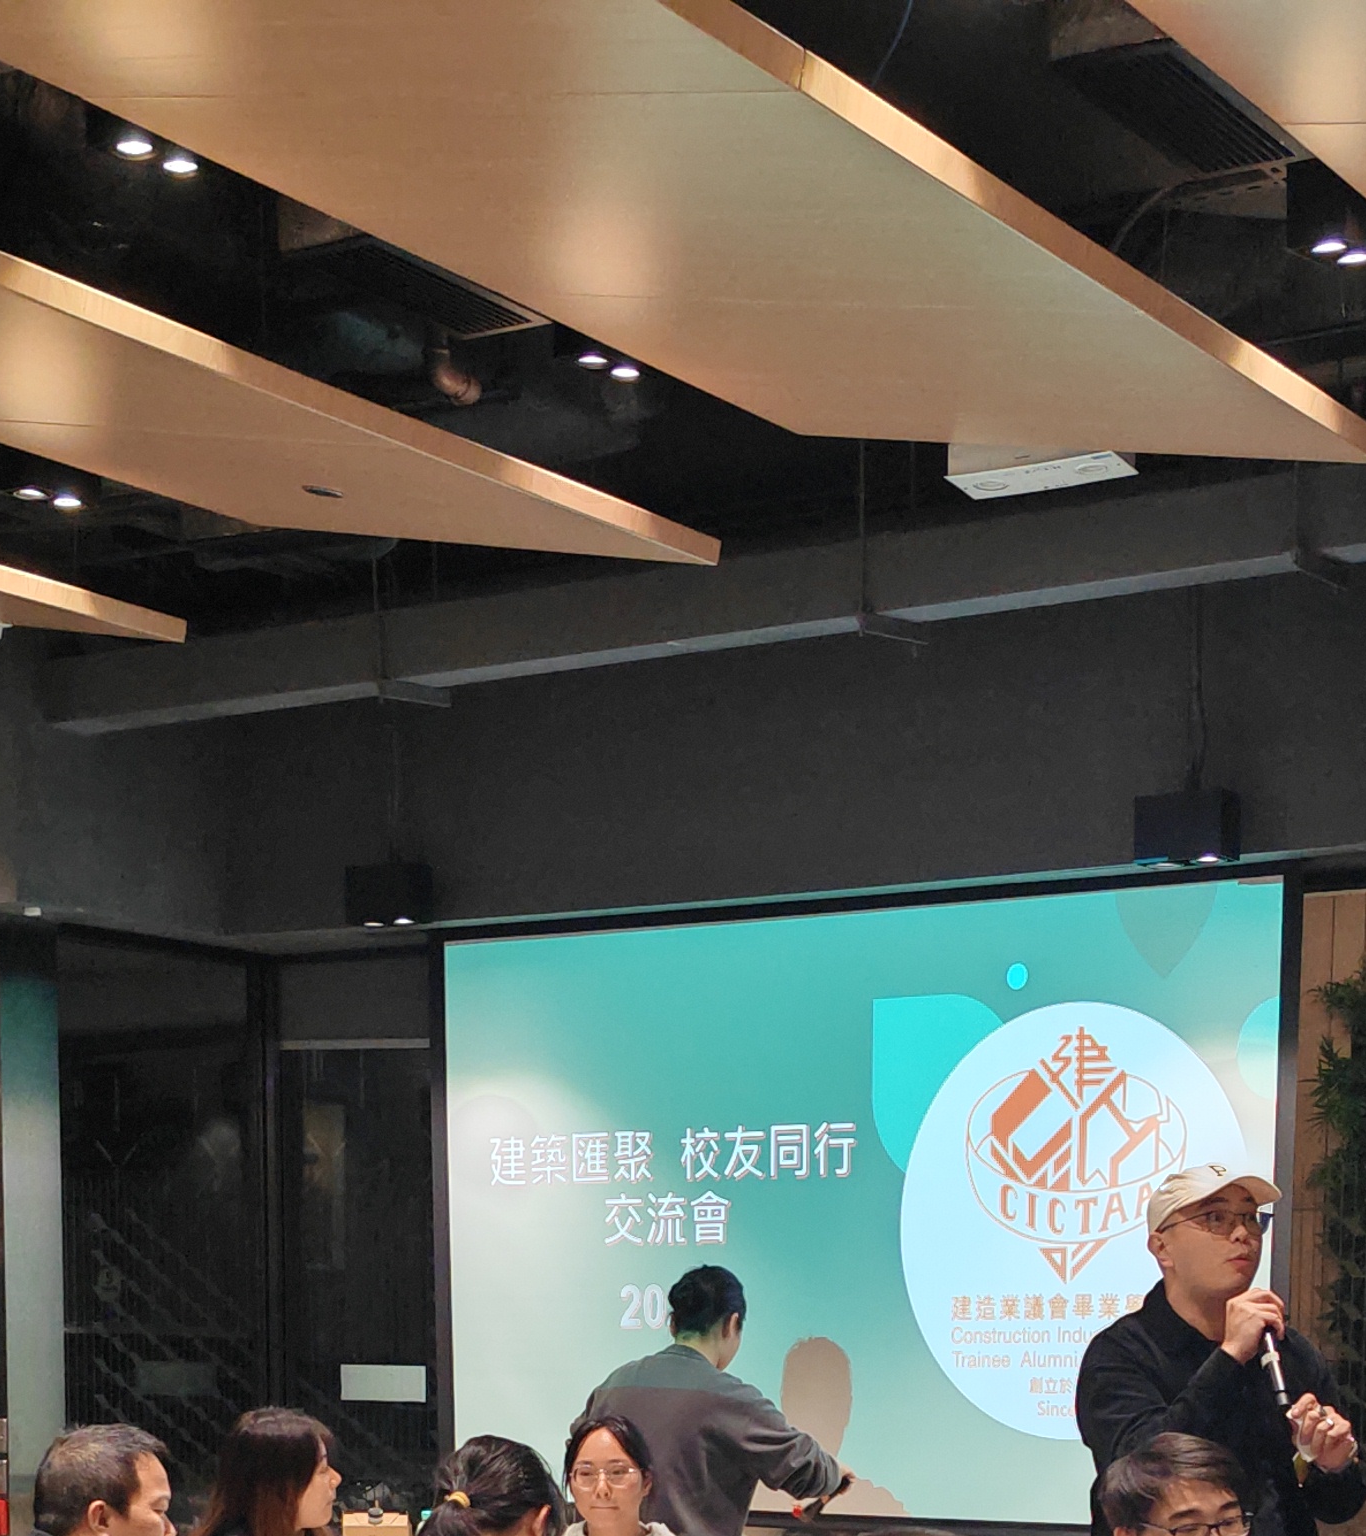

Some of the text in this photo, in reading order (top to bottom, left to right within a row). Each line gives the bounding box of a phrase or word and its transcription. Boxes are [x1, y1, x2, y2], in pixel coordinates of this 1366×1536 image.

[489, 1122, 857, 1186] 建築匯聚 校友同行
[604, 1190, 732, 1246] 交流會
[619, 1284, 669, 1330] 20
[951, 1292, 1145, 1321] 建造業議會畢業學
[951, 1326, 1094, 1345] Construction Indu
[952, 1350, 1078, 1369] Trainee Alumni
